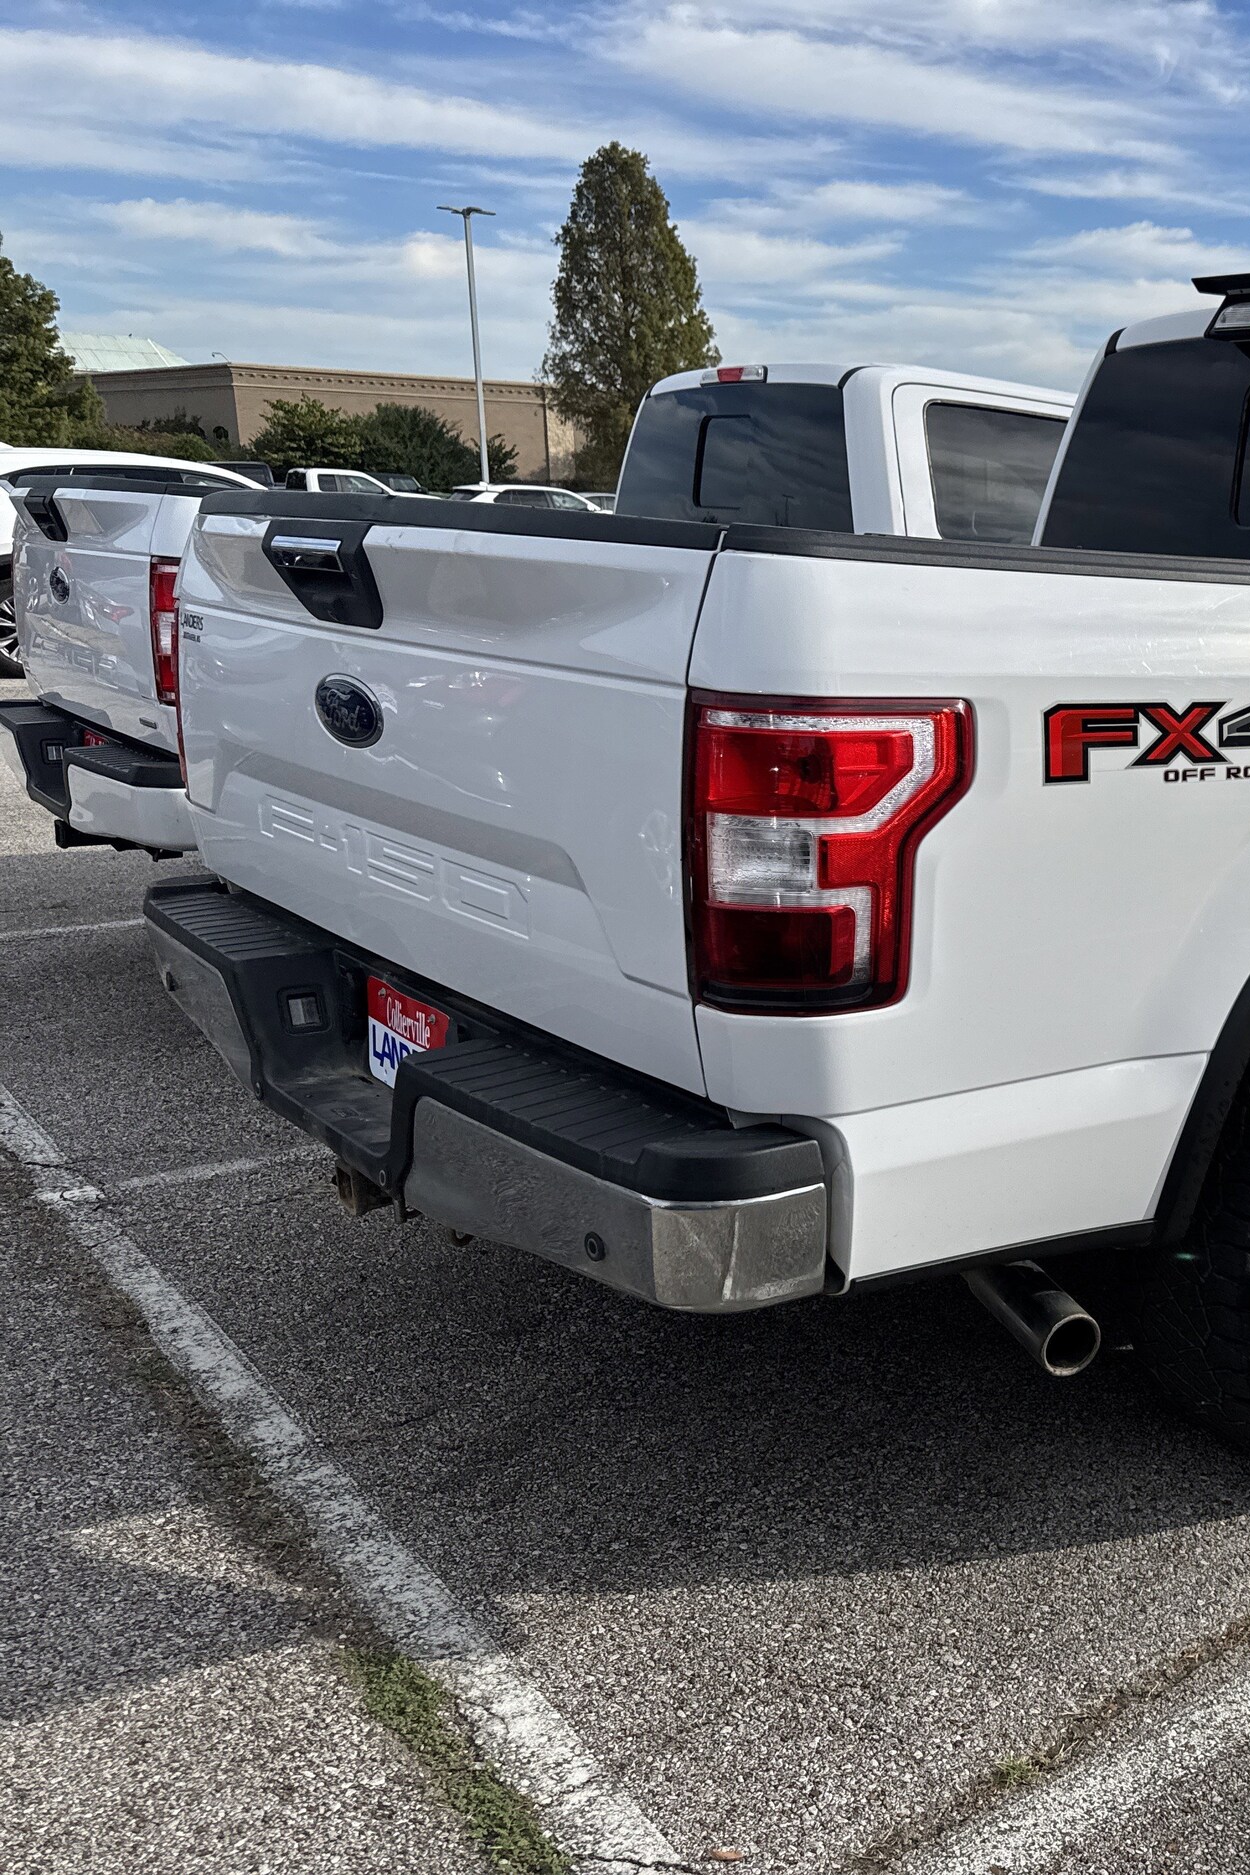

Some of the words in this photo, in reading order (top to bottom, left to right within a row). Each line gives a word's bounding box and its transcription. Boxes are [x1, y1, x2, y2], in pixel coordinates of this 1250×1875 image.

[181, 612, 204, 631] LANDERS
[325, 688, 361, 732] Ford
[1163, 767, 1216, 783] OFF
[258, 793, 530, 940] F-150
[386, 997, 431, 1049] Collierville
[372, 1023, 422, 1071] LAND
